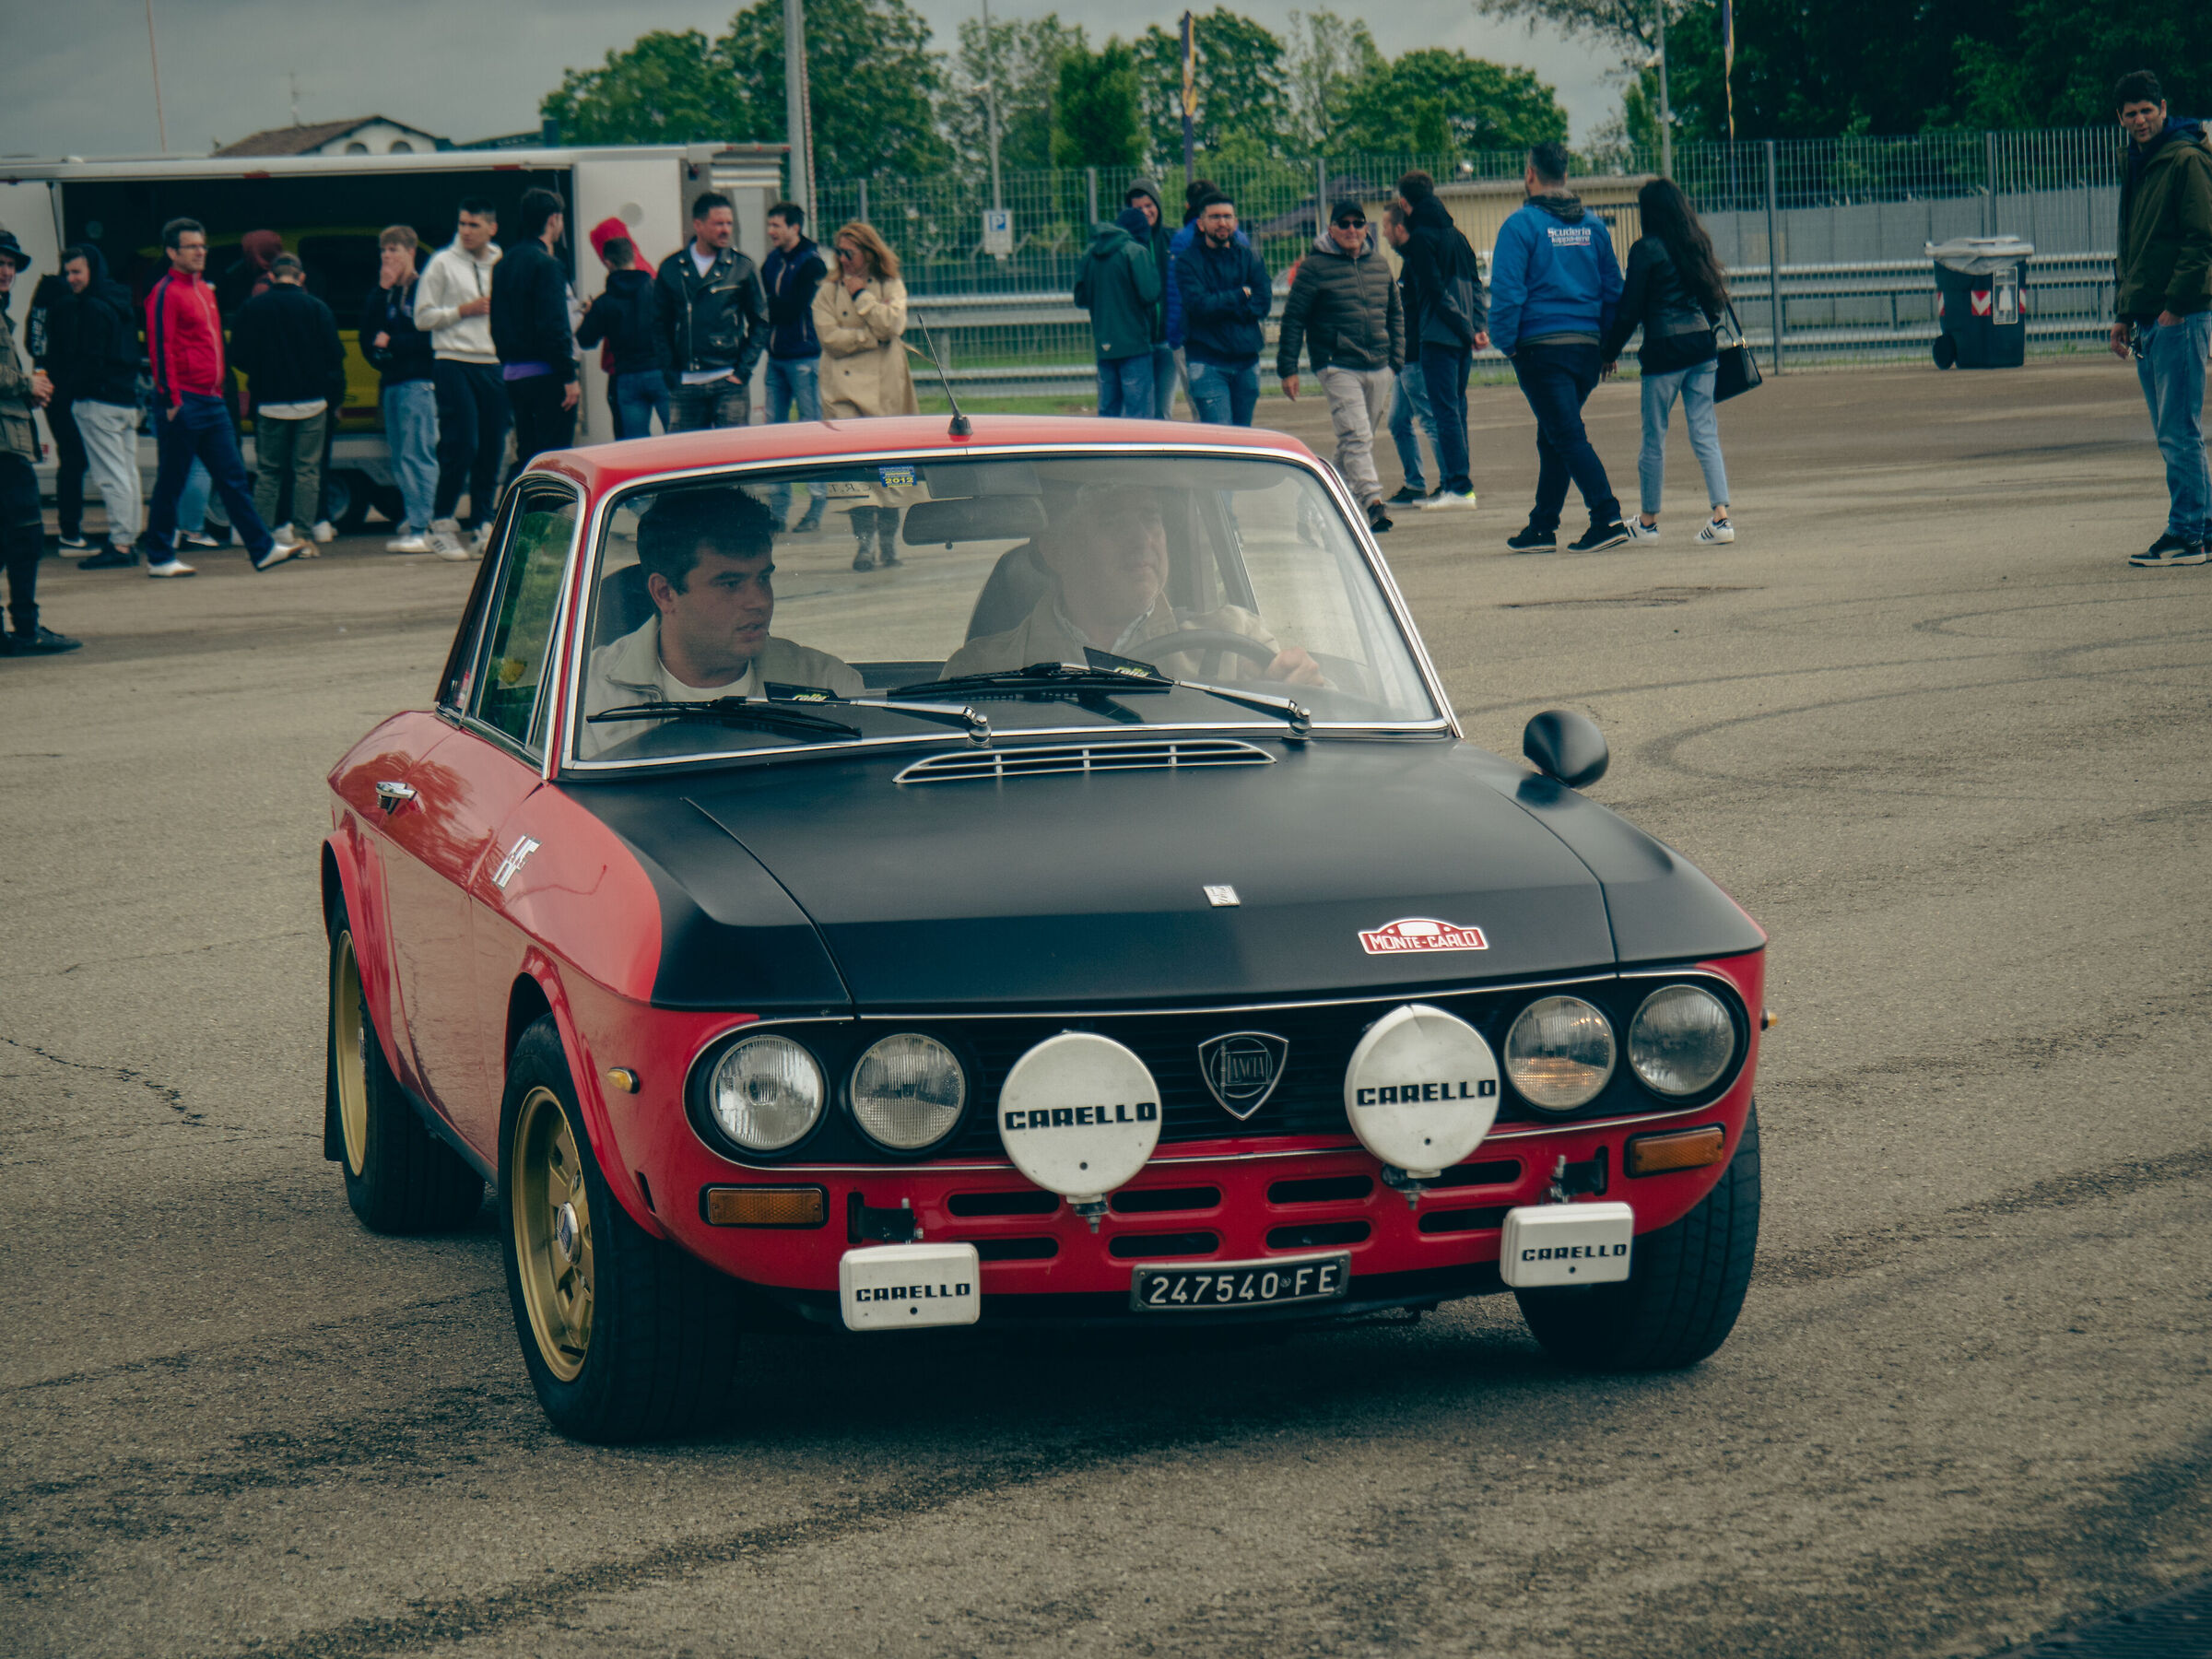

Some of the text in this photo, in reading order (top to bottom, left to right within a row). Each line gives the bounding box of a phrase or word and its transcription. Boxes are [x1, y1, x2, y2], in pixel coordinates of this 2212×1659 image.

[885, 477, 913, 485] 2012
[1369, 931, 1478, 950] MONTE-CARLO
[1357, 1079, 1496, 1106] CARELLO
[1005, 1102, 1157, 1131] CARELLO
[1522, 1244, 1627, 1262] CARELLO
[856, 1283, 971, 1302] CARELLO
[1150, 1265, 1337, 1304] 247540 FE
